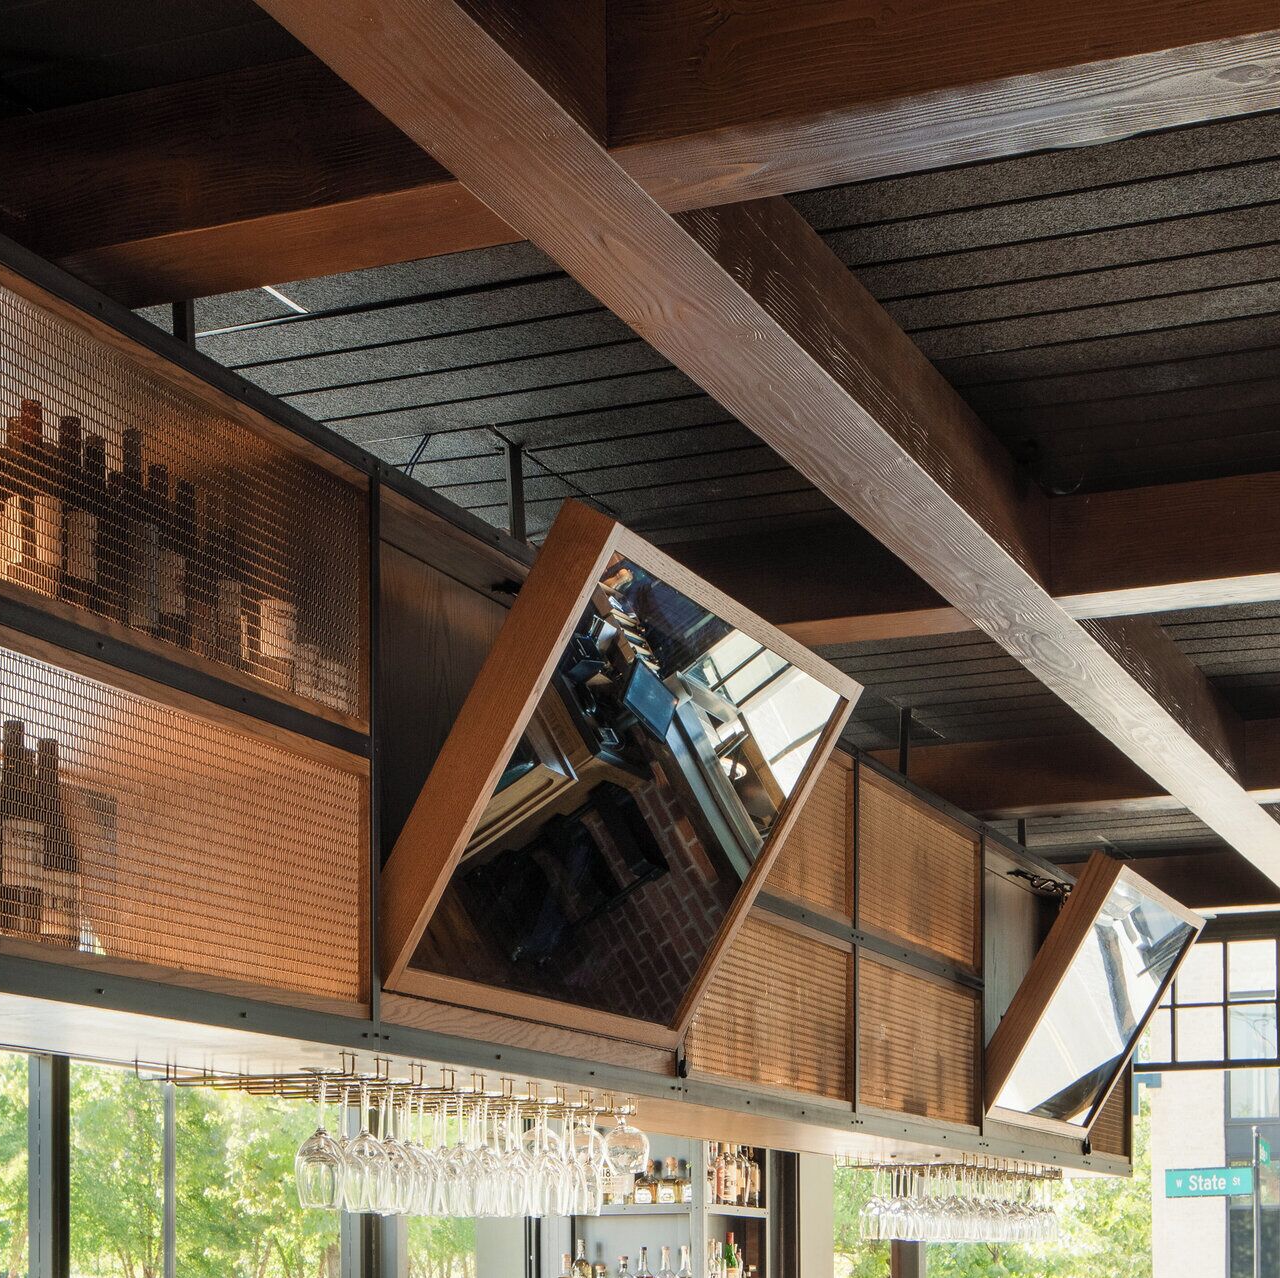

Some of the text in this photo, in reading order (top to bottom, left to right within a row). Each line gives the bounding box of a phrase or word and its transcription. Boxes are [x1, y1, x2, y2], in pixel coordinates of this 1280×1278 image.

[1176, 1175, 1241, 1191] W State St
